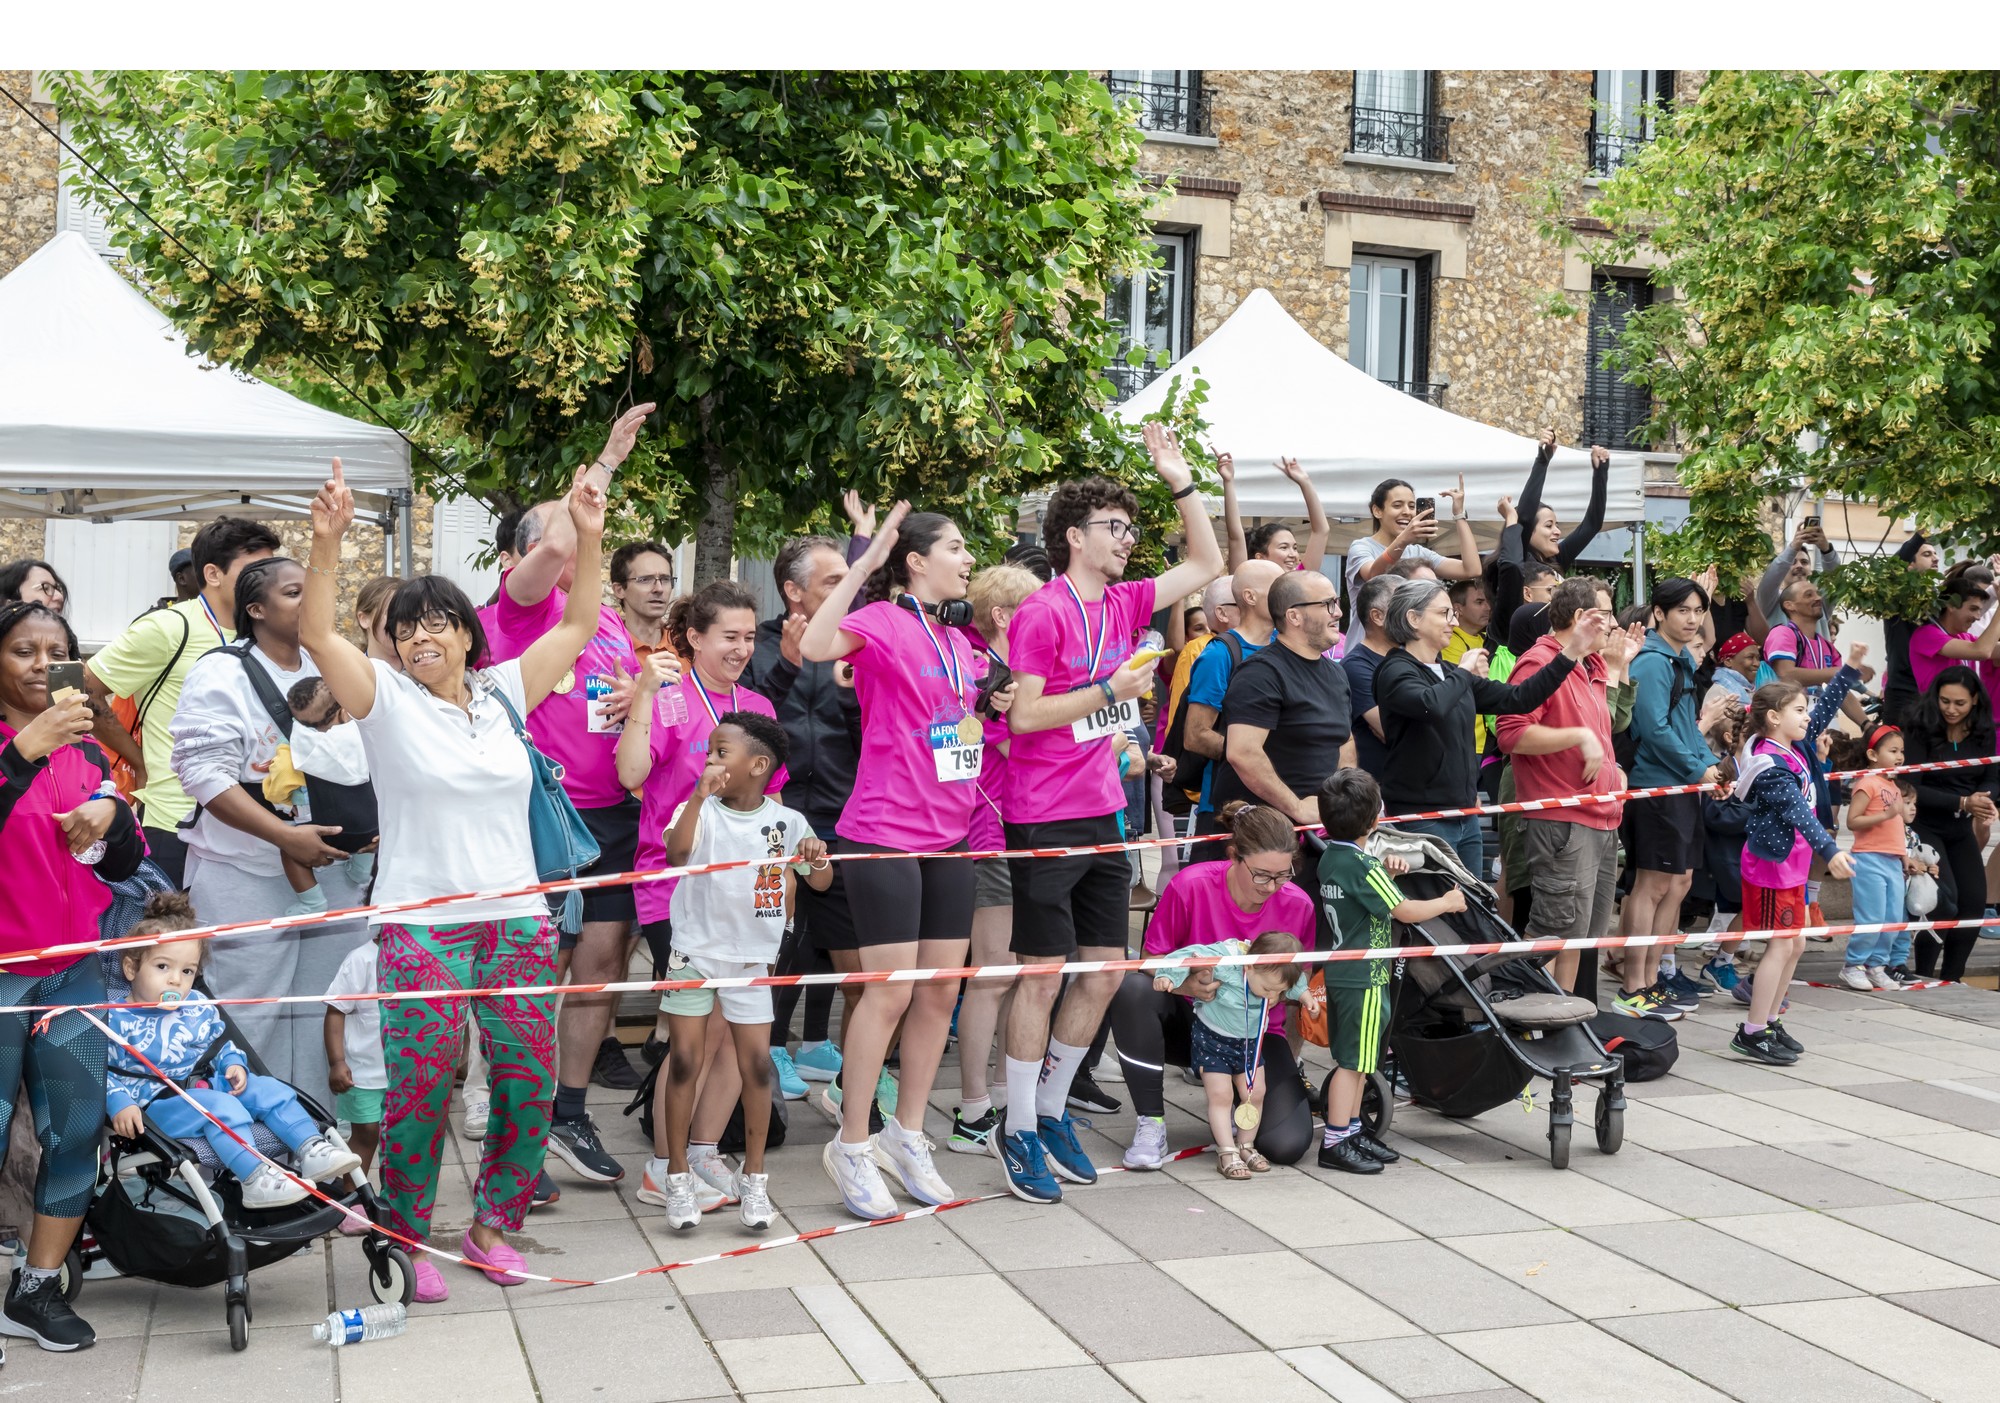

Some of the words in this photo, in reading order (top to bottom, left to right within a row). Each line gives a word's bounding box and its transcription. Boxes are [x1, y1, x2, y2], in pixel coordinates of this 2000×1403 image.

[586, 678, 596, 688] LA
[1086, 702, 1131, 730] 1090
[931, 727, 940, 737] LA
[1099, 723, 1127, 735] LUCAS
[951, 748, 979, 770] 799
